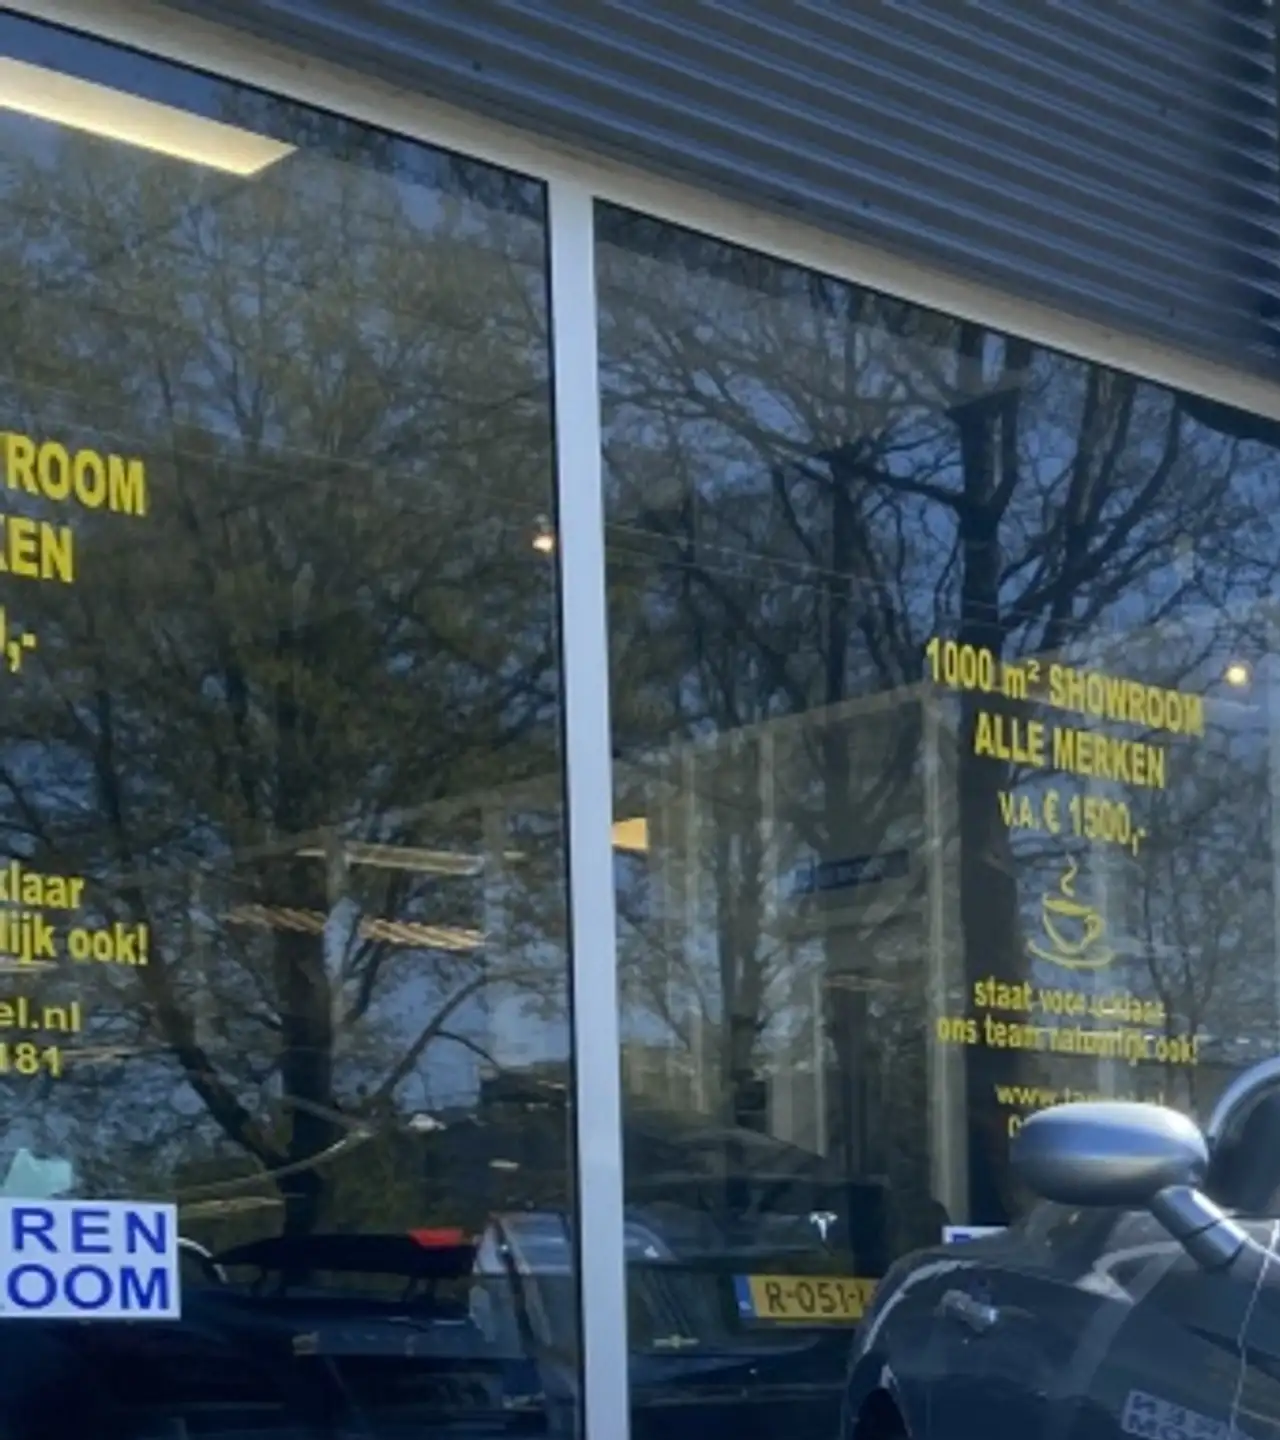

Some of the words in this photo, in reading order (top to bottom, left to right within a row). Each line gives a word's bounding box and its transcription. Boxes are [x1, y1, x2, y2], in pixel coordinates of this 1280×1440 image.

[0, 432, 146, 516] ROOM
[0, 512, 75, 583] EN
[926, 637, 994, 693] 1000
[1050, 663, 1206, 738] SHOWROOM
[975, 711, 1045, 768] ALLE
[1053, 727, 1166, 789] MERKEN
[67, 922, 149, 966] ook!
[974, 976, 1032, 1012] staat
[936, 1015, 977, 1045] ons
[984, 1014, 1042, 1051] team
[0, 1263, 170, 1311] OOM
